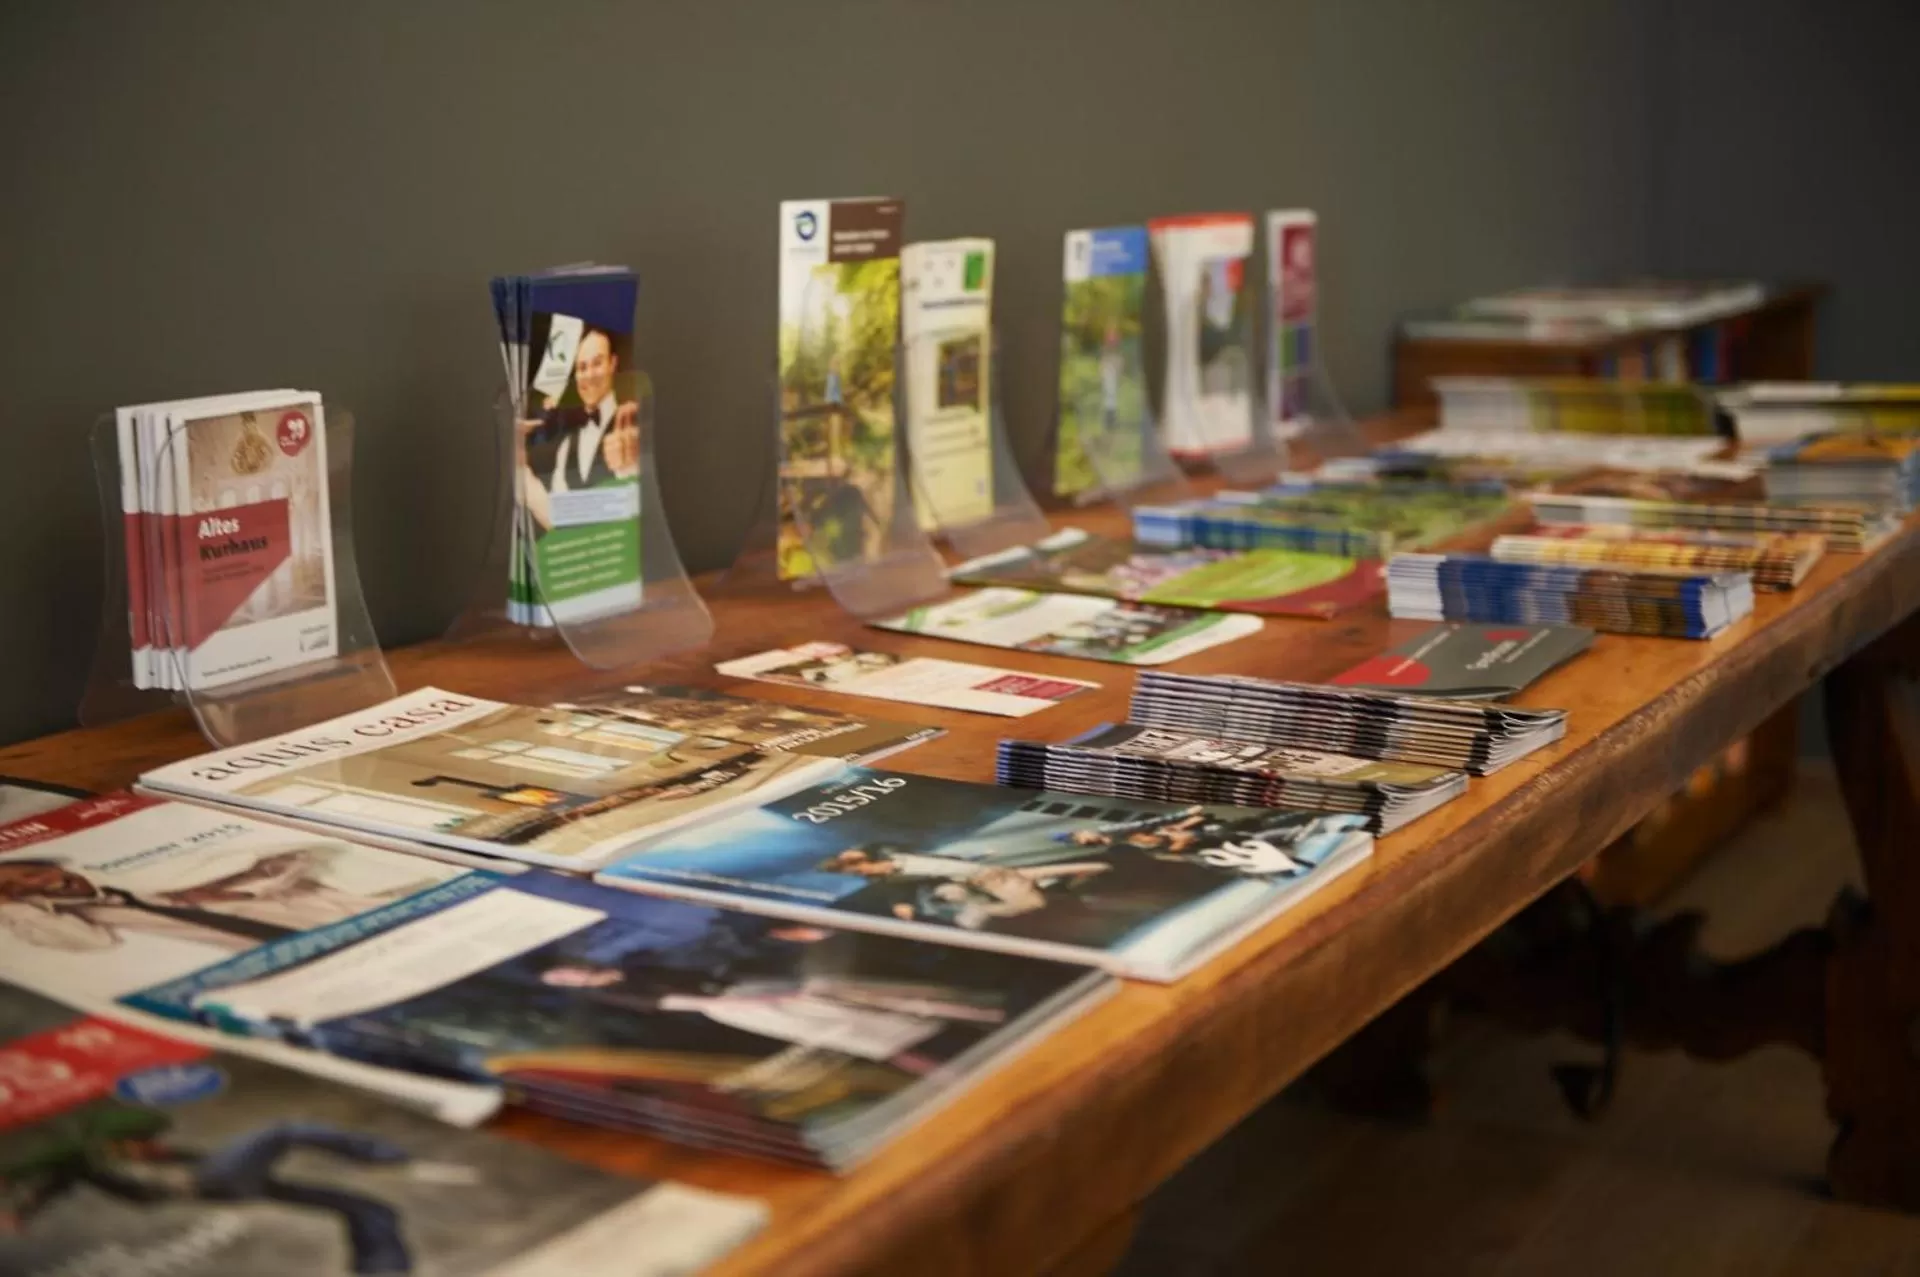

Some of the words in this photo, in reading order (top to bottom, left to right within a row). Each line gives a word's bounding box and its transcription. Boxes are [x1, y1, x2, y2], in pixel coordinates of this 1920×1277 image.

[198, 517, 240, 539] Altes
[191, 736, 353, 781] aquis
[353, 700, 474, 737] casa
[792, 777, 907, 824] 2015/16
